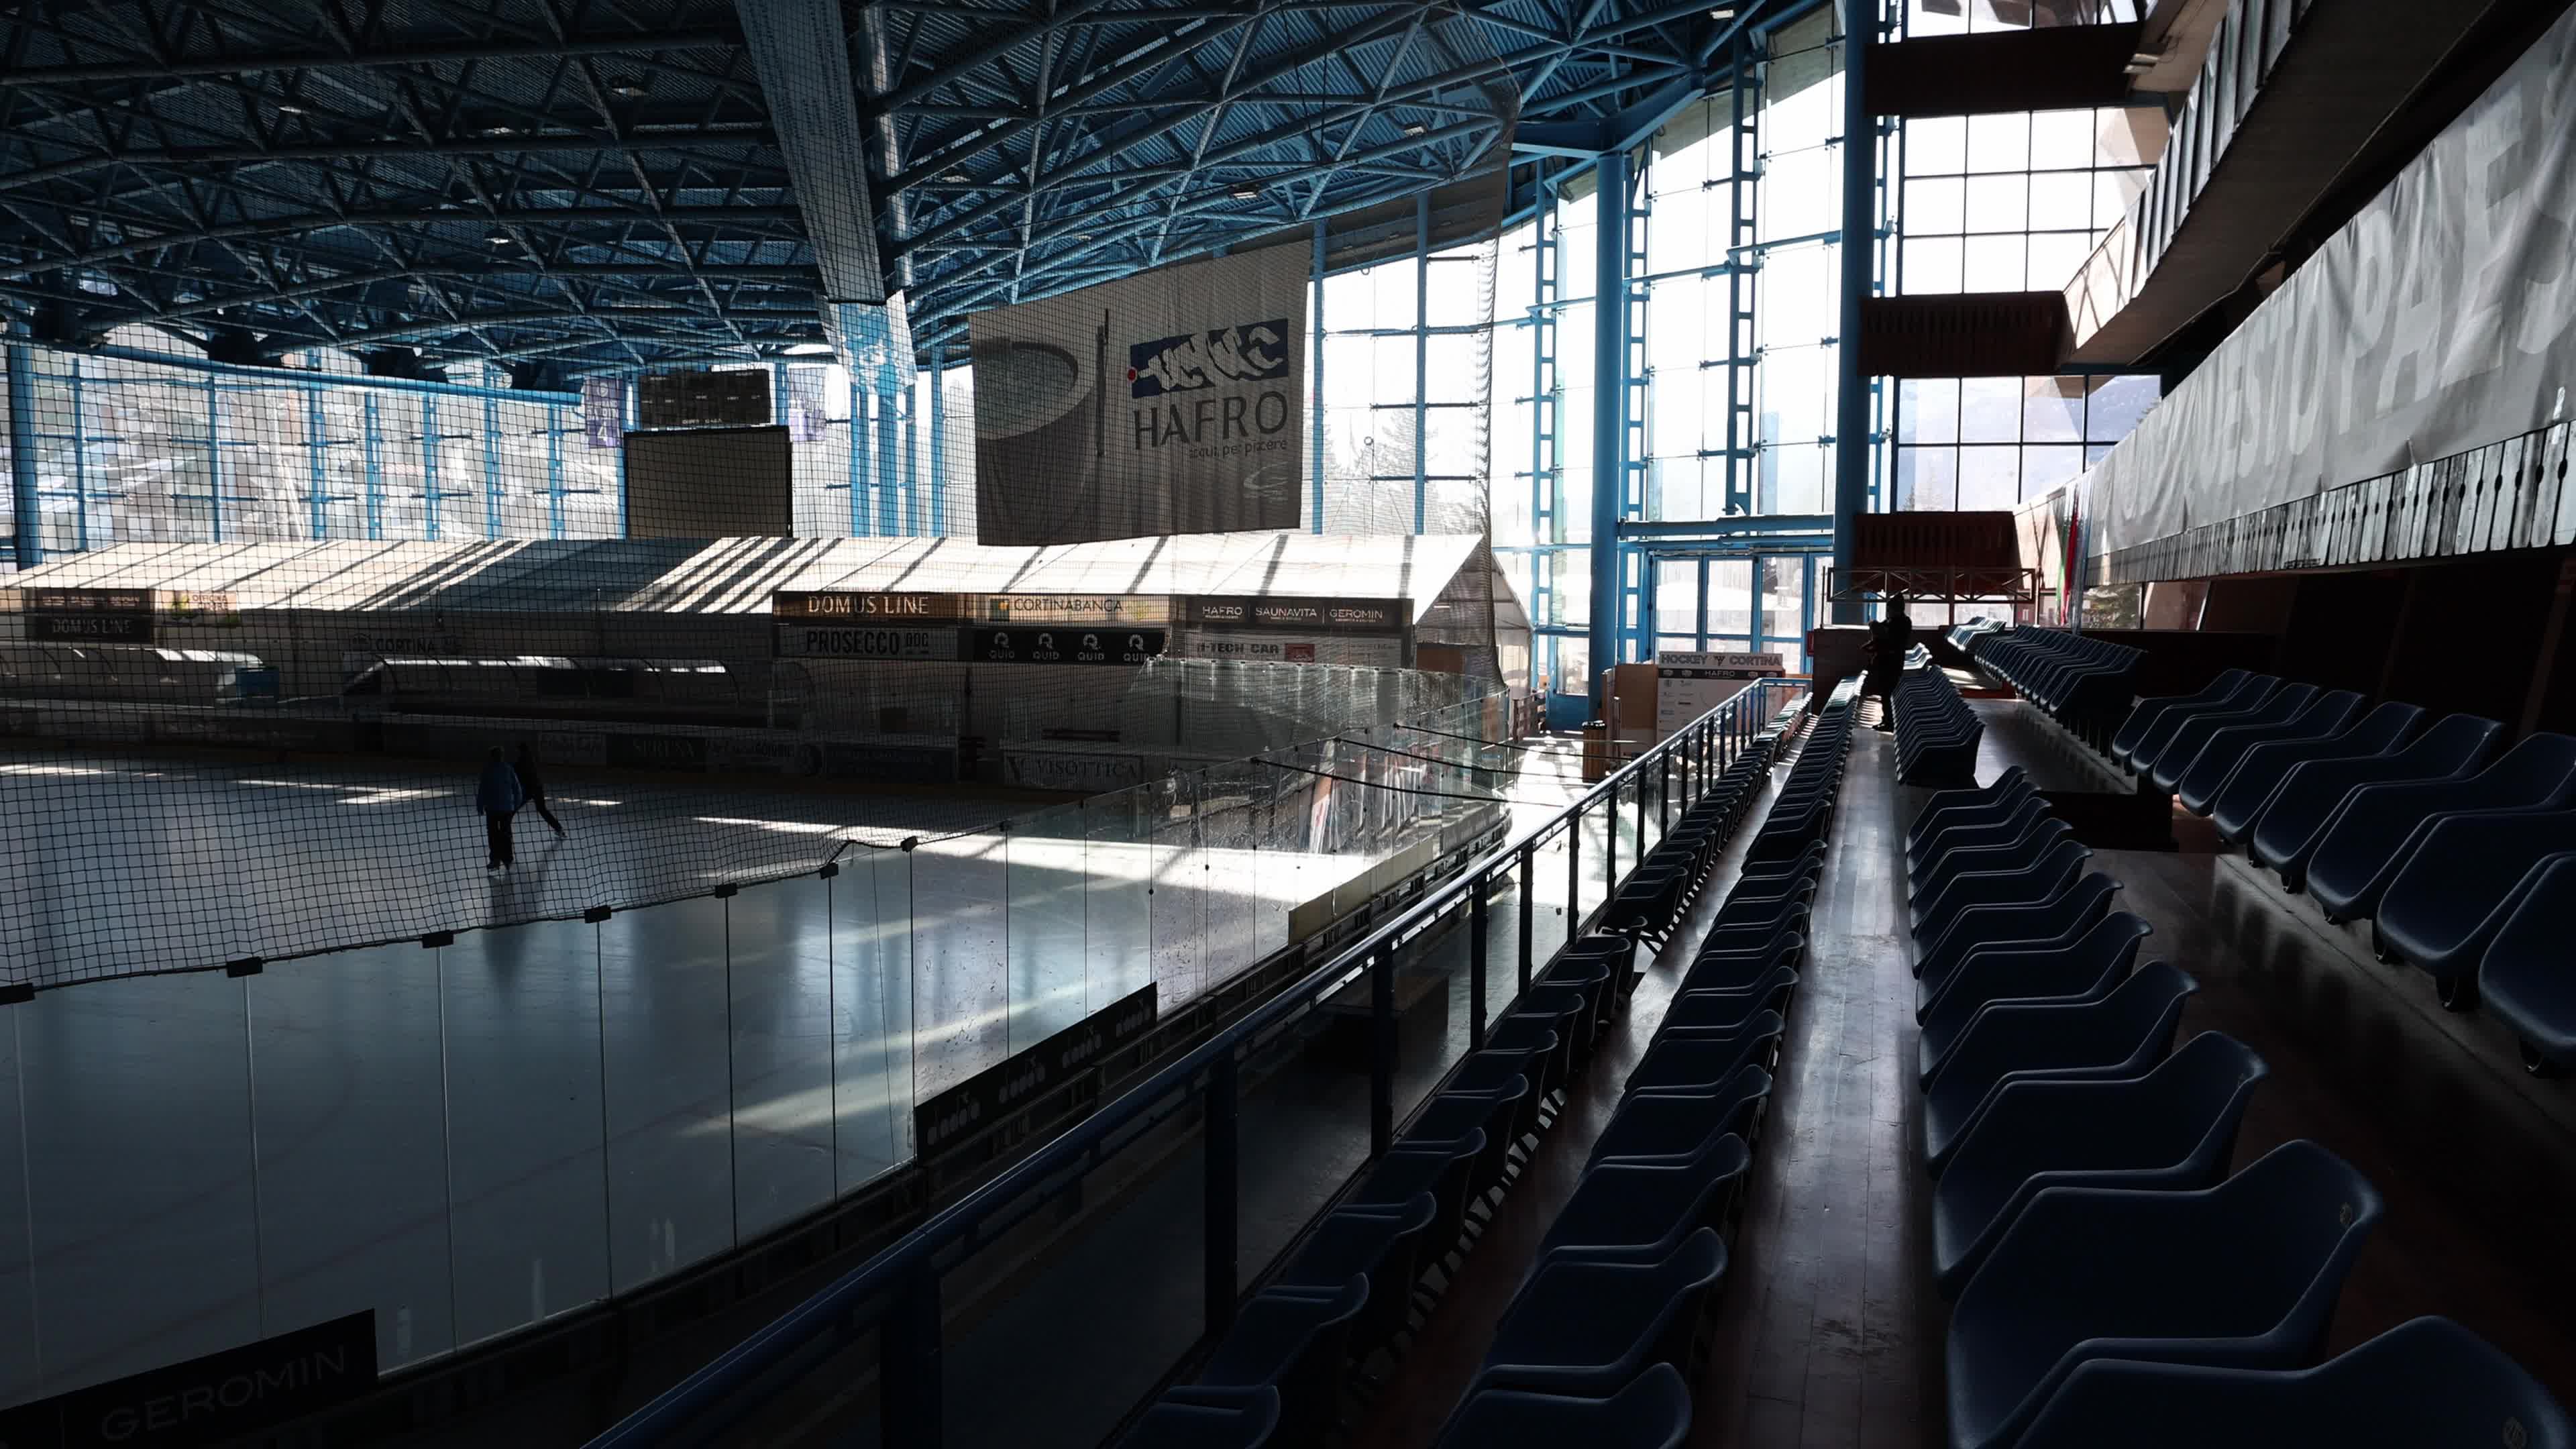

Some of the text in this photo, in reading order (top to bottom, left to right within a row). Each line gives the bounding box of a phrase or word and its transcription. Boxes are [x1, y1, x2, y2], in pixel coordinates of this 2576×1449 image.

[1134, 391, 1287, 449] HAFRO
[808, 596, 928, 614] DOMUS LINE
[1014, 598, 1123, 612] CORTINABANCA
[1202, 606, 1242, 616] HAFRO
[1255, 606, 1317, 618] SAUNAVITA
[1330, 608, 1383, 619] GEROMIN
[806, 630, 900, 655] PROSECCO
[1250, 643, 1279, 654] CAR
[1032, 650, 1060, 661] QUID
[1077, 651, 1105, 661] QUID
[1661, 654, 1782, 666] HOCKEY CORTINA
[101, 1343, 345, 1442] GEROMIN
